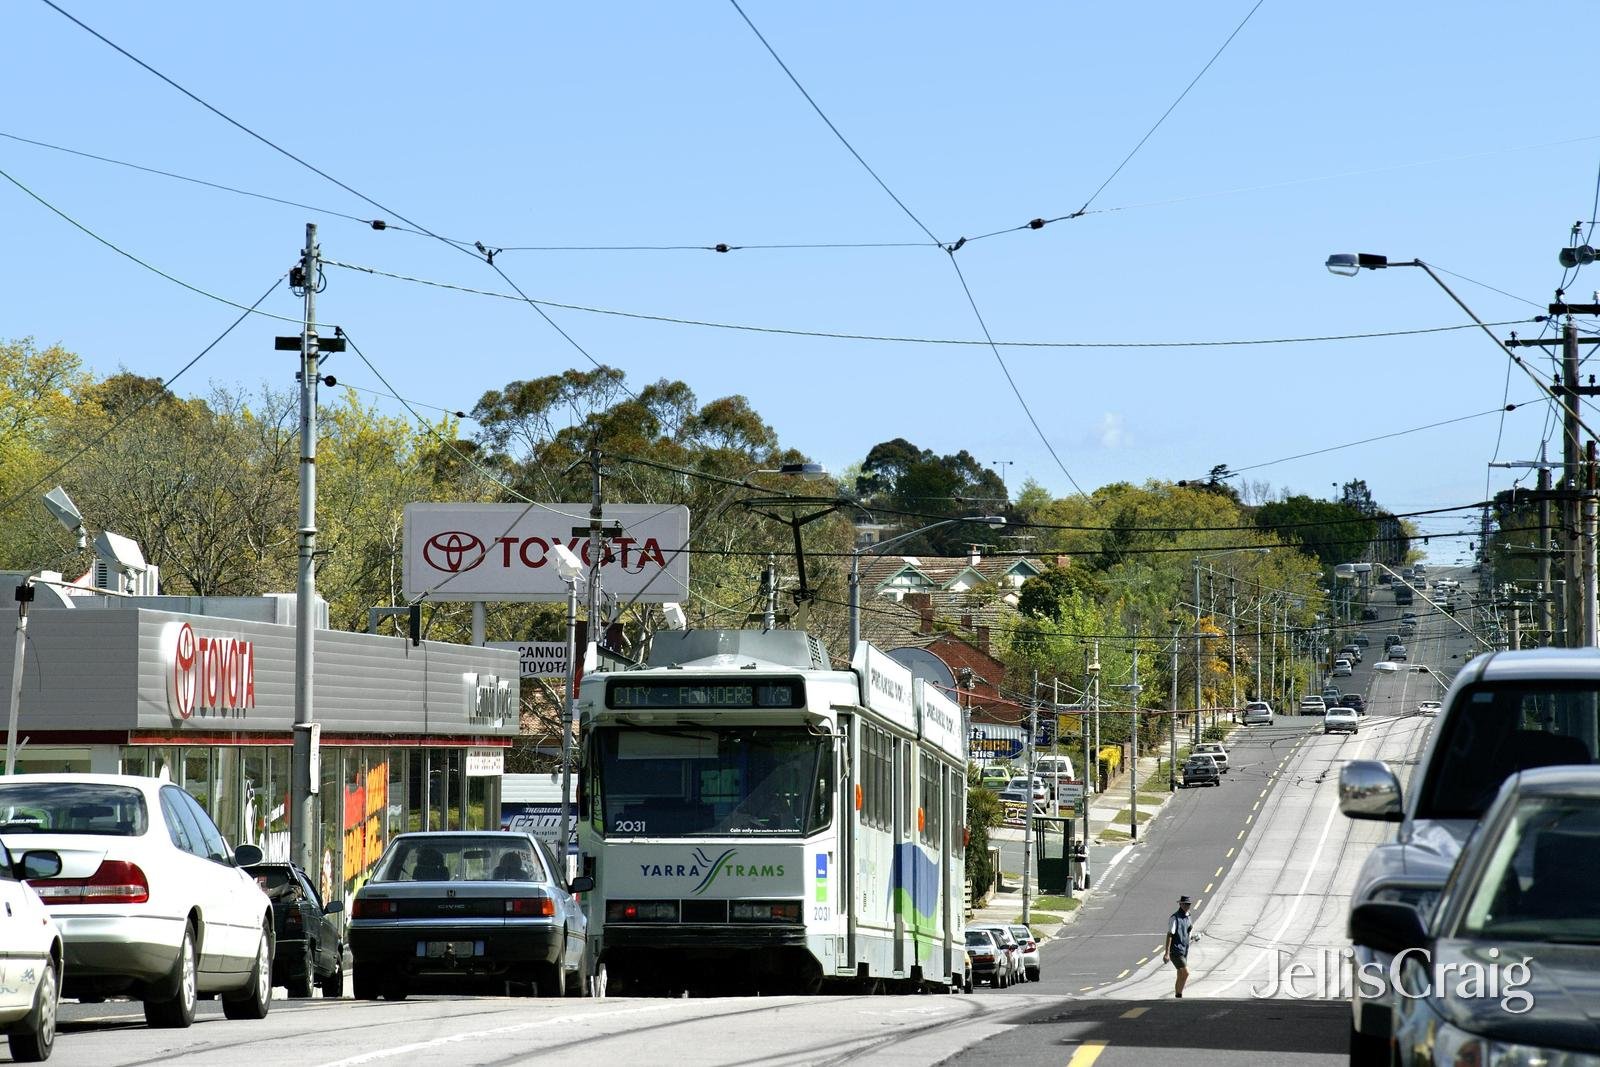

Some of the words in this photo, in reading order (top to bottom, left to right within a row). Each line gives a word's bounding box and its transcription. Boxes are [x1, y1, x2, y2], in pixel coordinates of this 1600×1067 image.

[495, 537, 666, 569] TOYOTA
[199, 638, 255, 709] TOYOTA
[614, 687, 651, 704] CITY
[615, 821, 646, 833] 2031
[641, 865, 700, 877] YARRA
[725, 865, 785, 877] TRAMS
[814, 907, 831, 921] 2031
